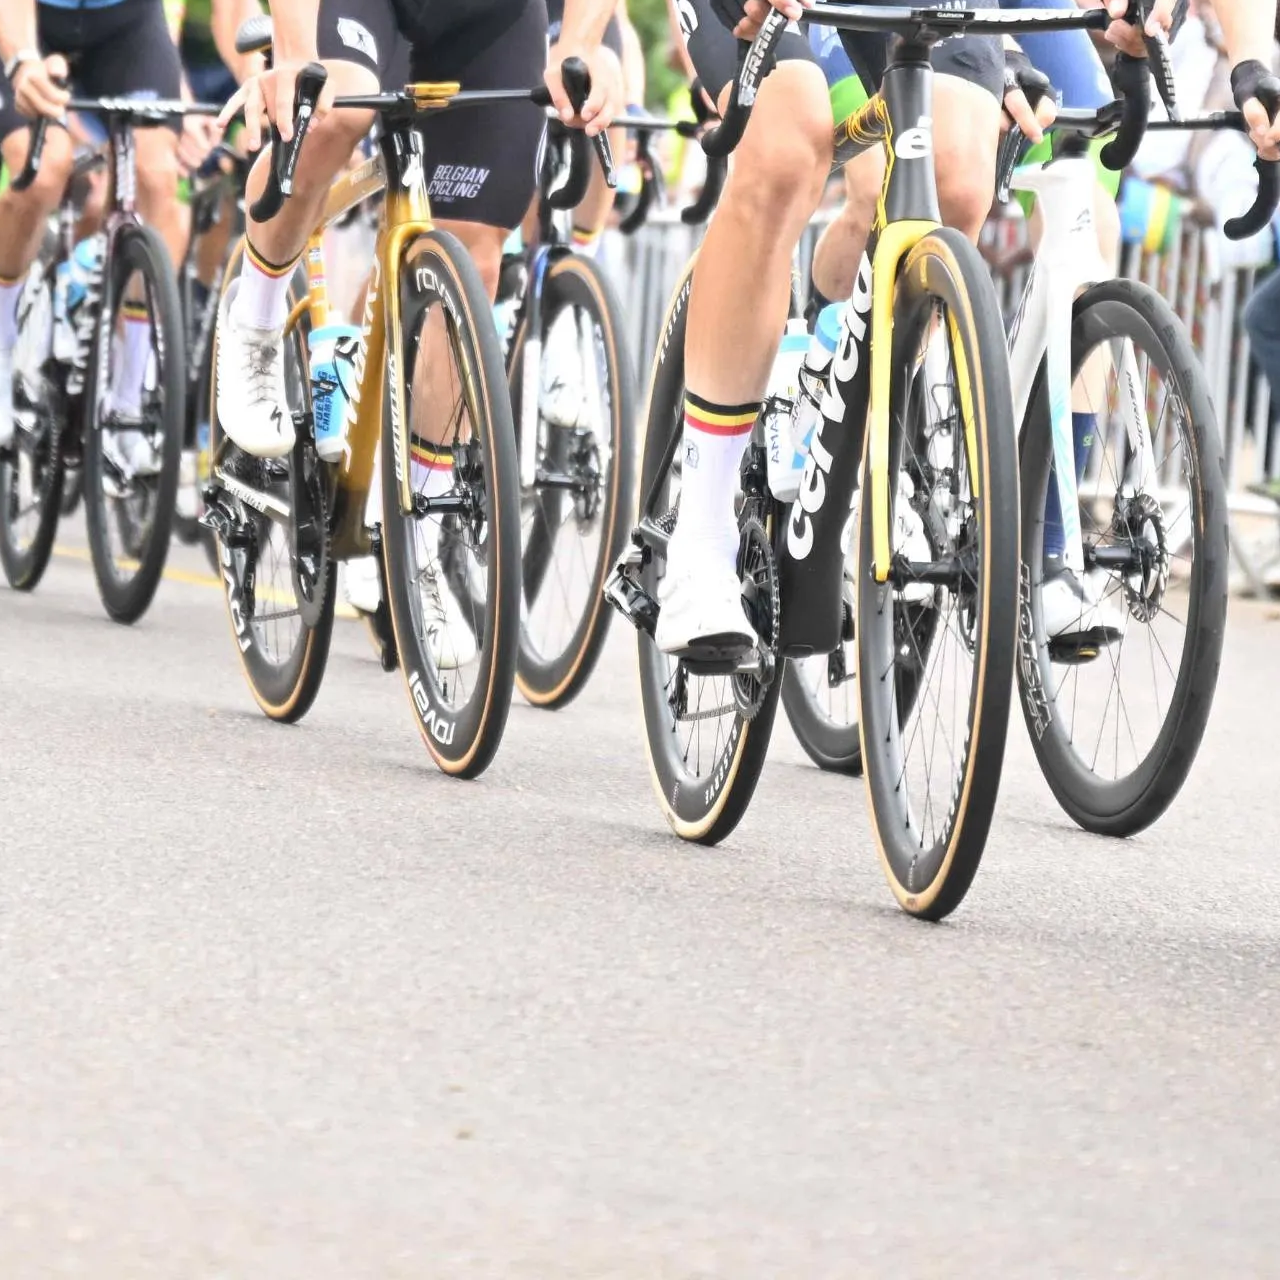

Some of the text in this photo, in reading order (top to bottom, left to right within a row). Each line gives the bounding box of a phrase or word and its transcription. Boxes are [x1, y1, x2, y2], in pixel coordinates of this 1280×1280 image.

[936, 11, 965, 19] GARMIN
[433, 164, 490, 185] BELGIAN
[427, 179, 482, 199] CYCLING
[407, 669, 458, 746] roval
